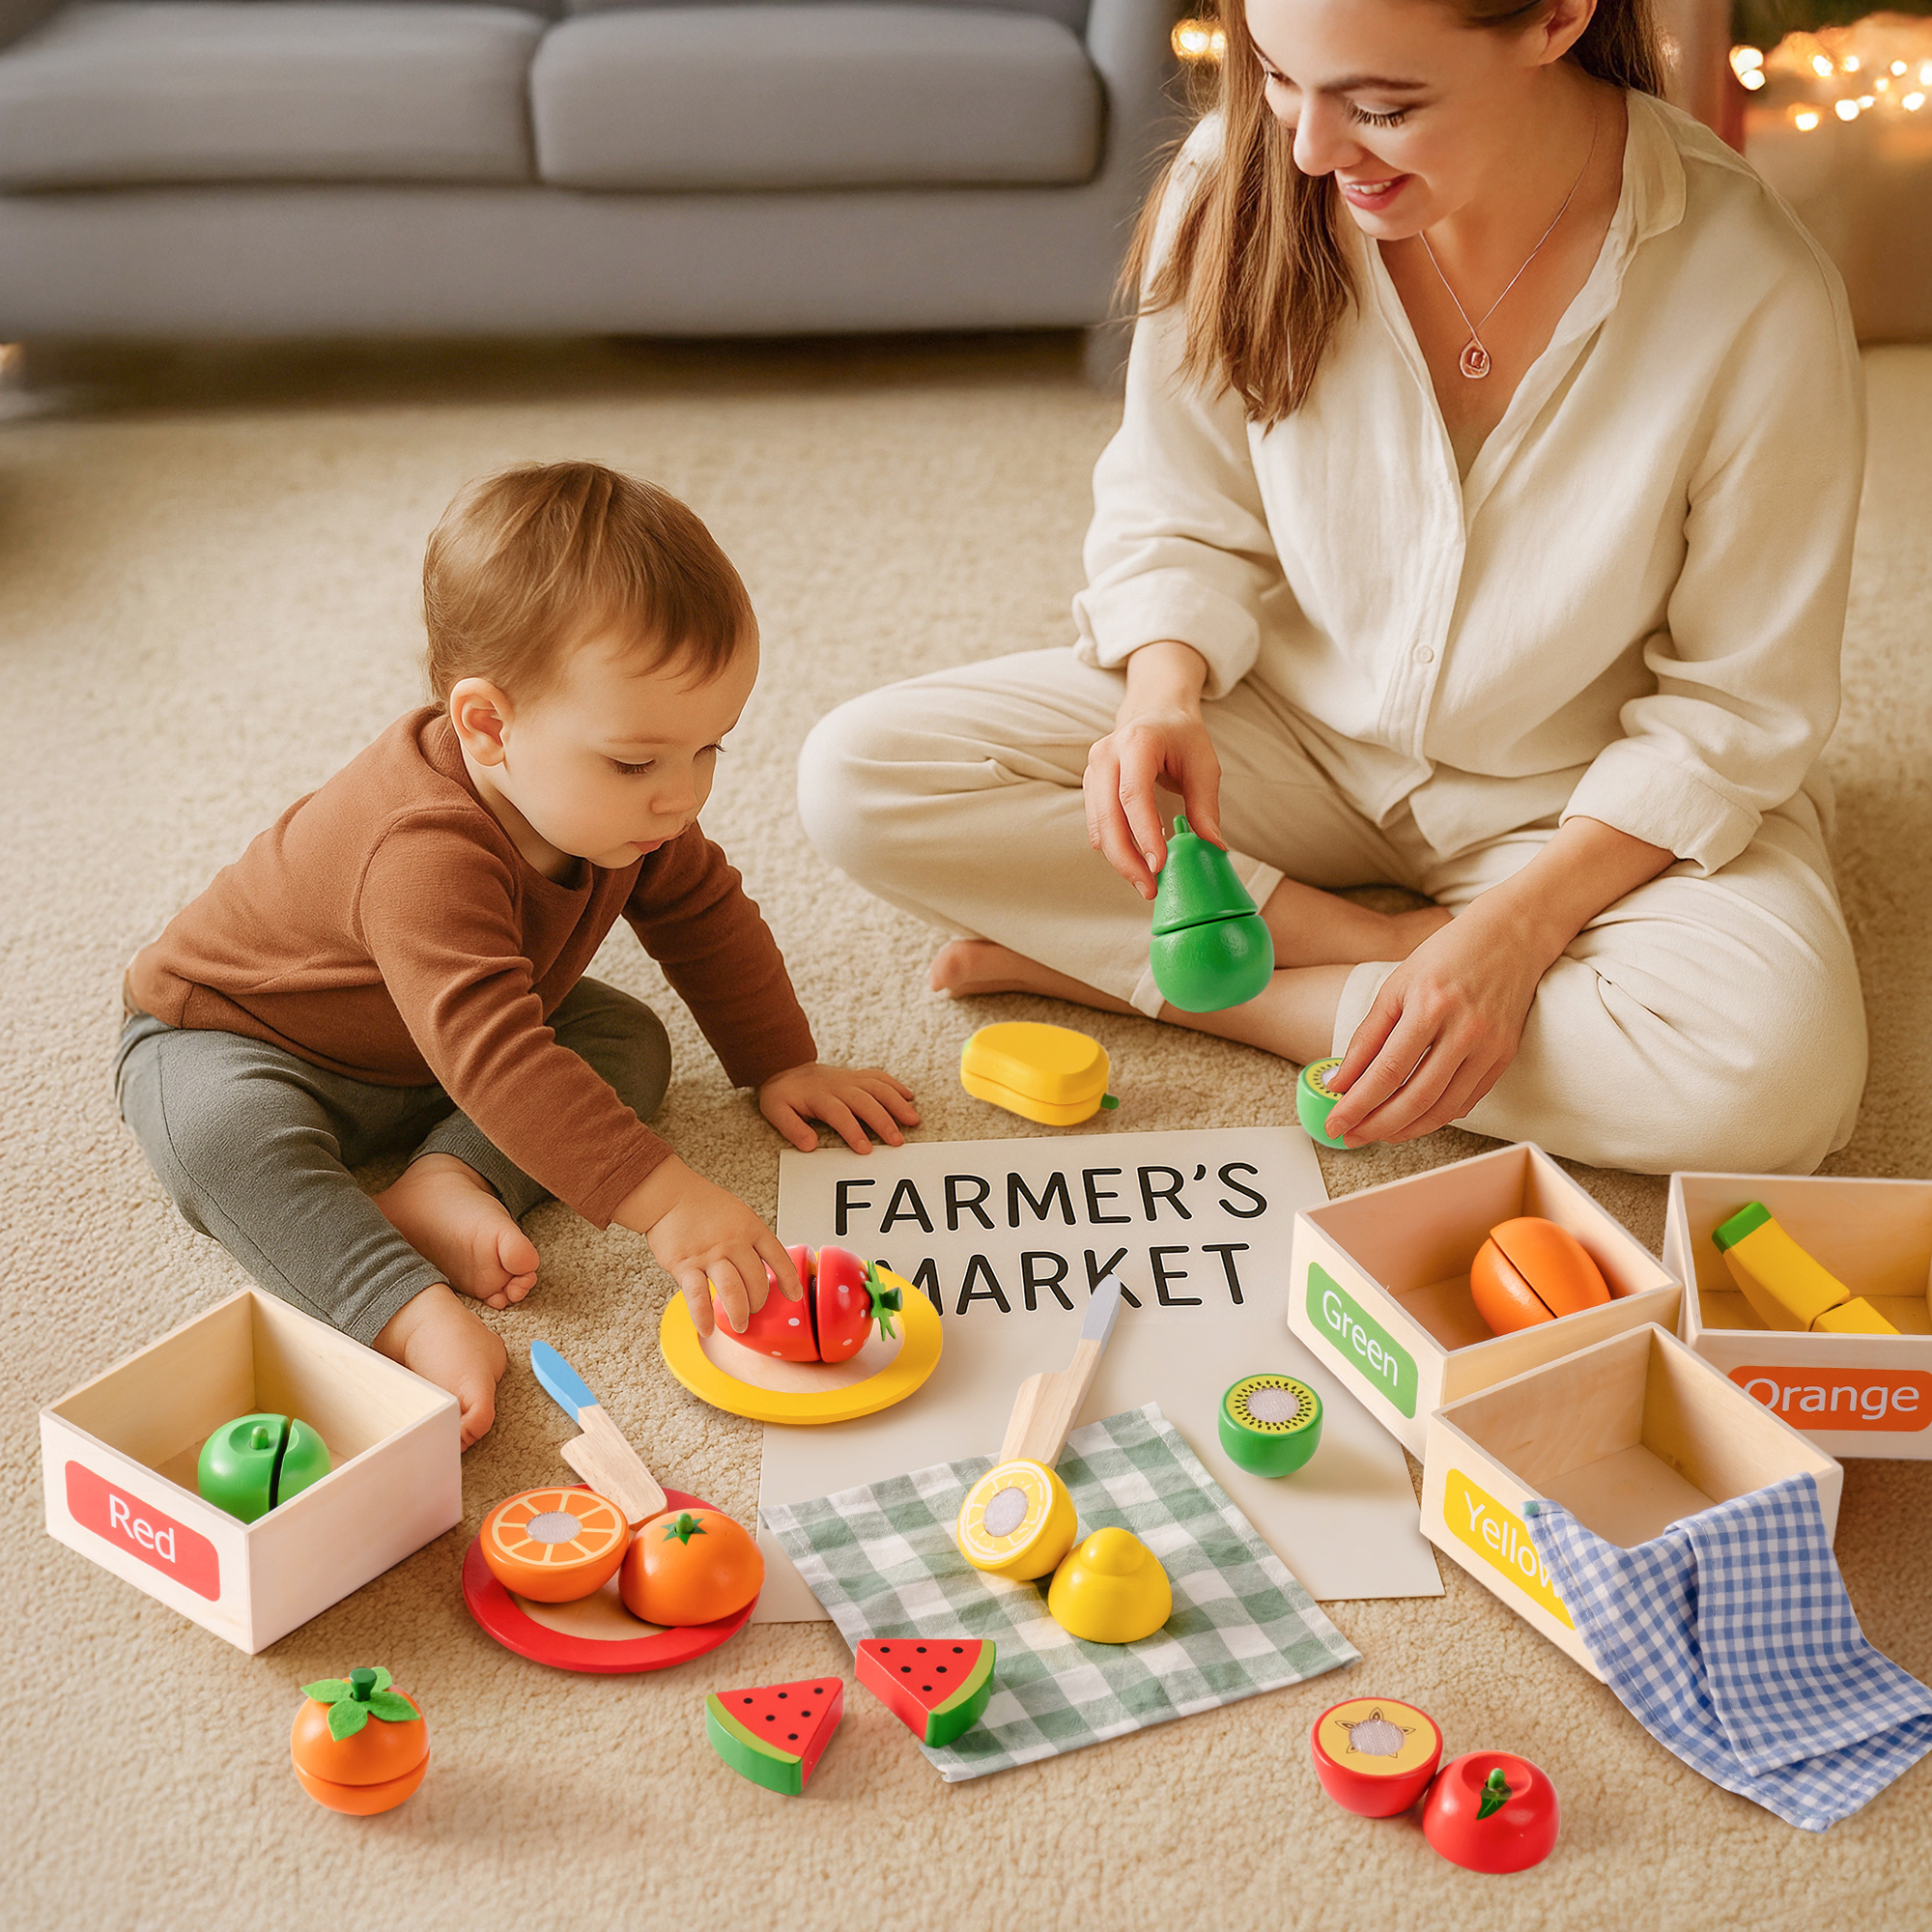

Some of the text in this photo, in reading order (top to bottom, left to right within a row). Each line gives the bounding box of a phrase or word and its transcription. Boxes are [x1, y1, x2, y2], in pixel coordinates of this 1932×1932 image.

[834, 1162, 1267, 1236] FARMER'S
[1322, 1290, 1398, 1387] Green
[1743, 1378, 1919, 1421] Orange
[109, 1493, 176, 1563] Red
